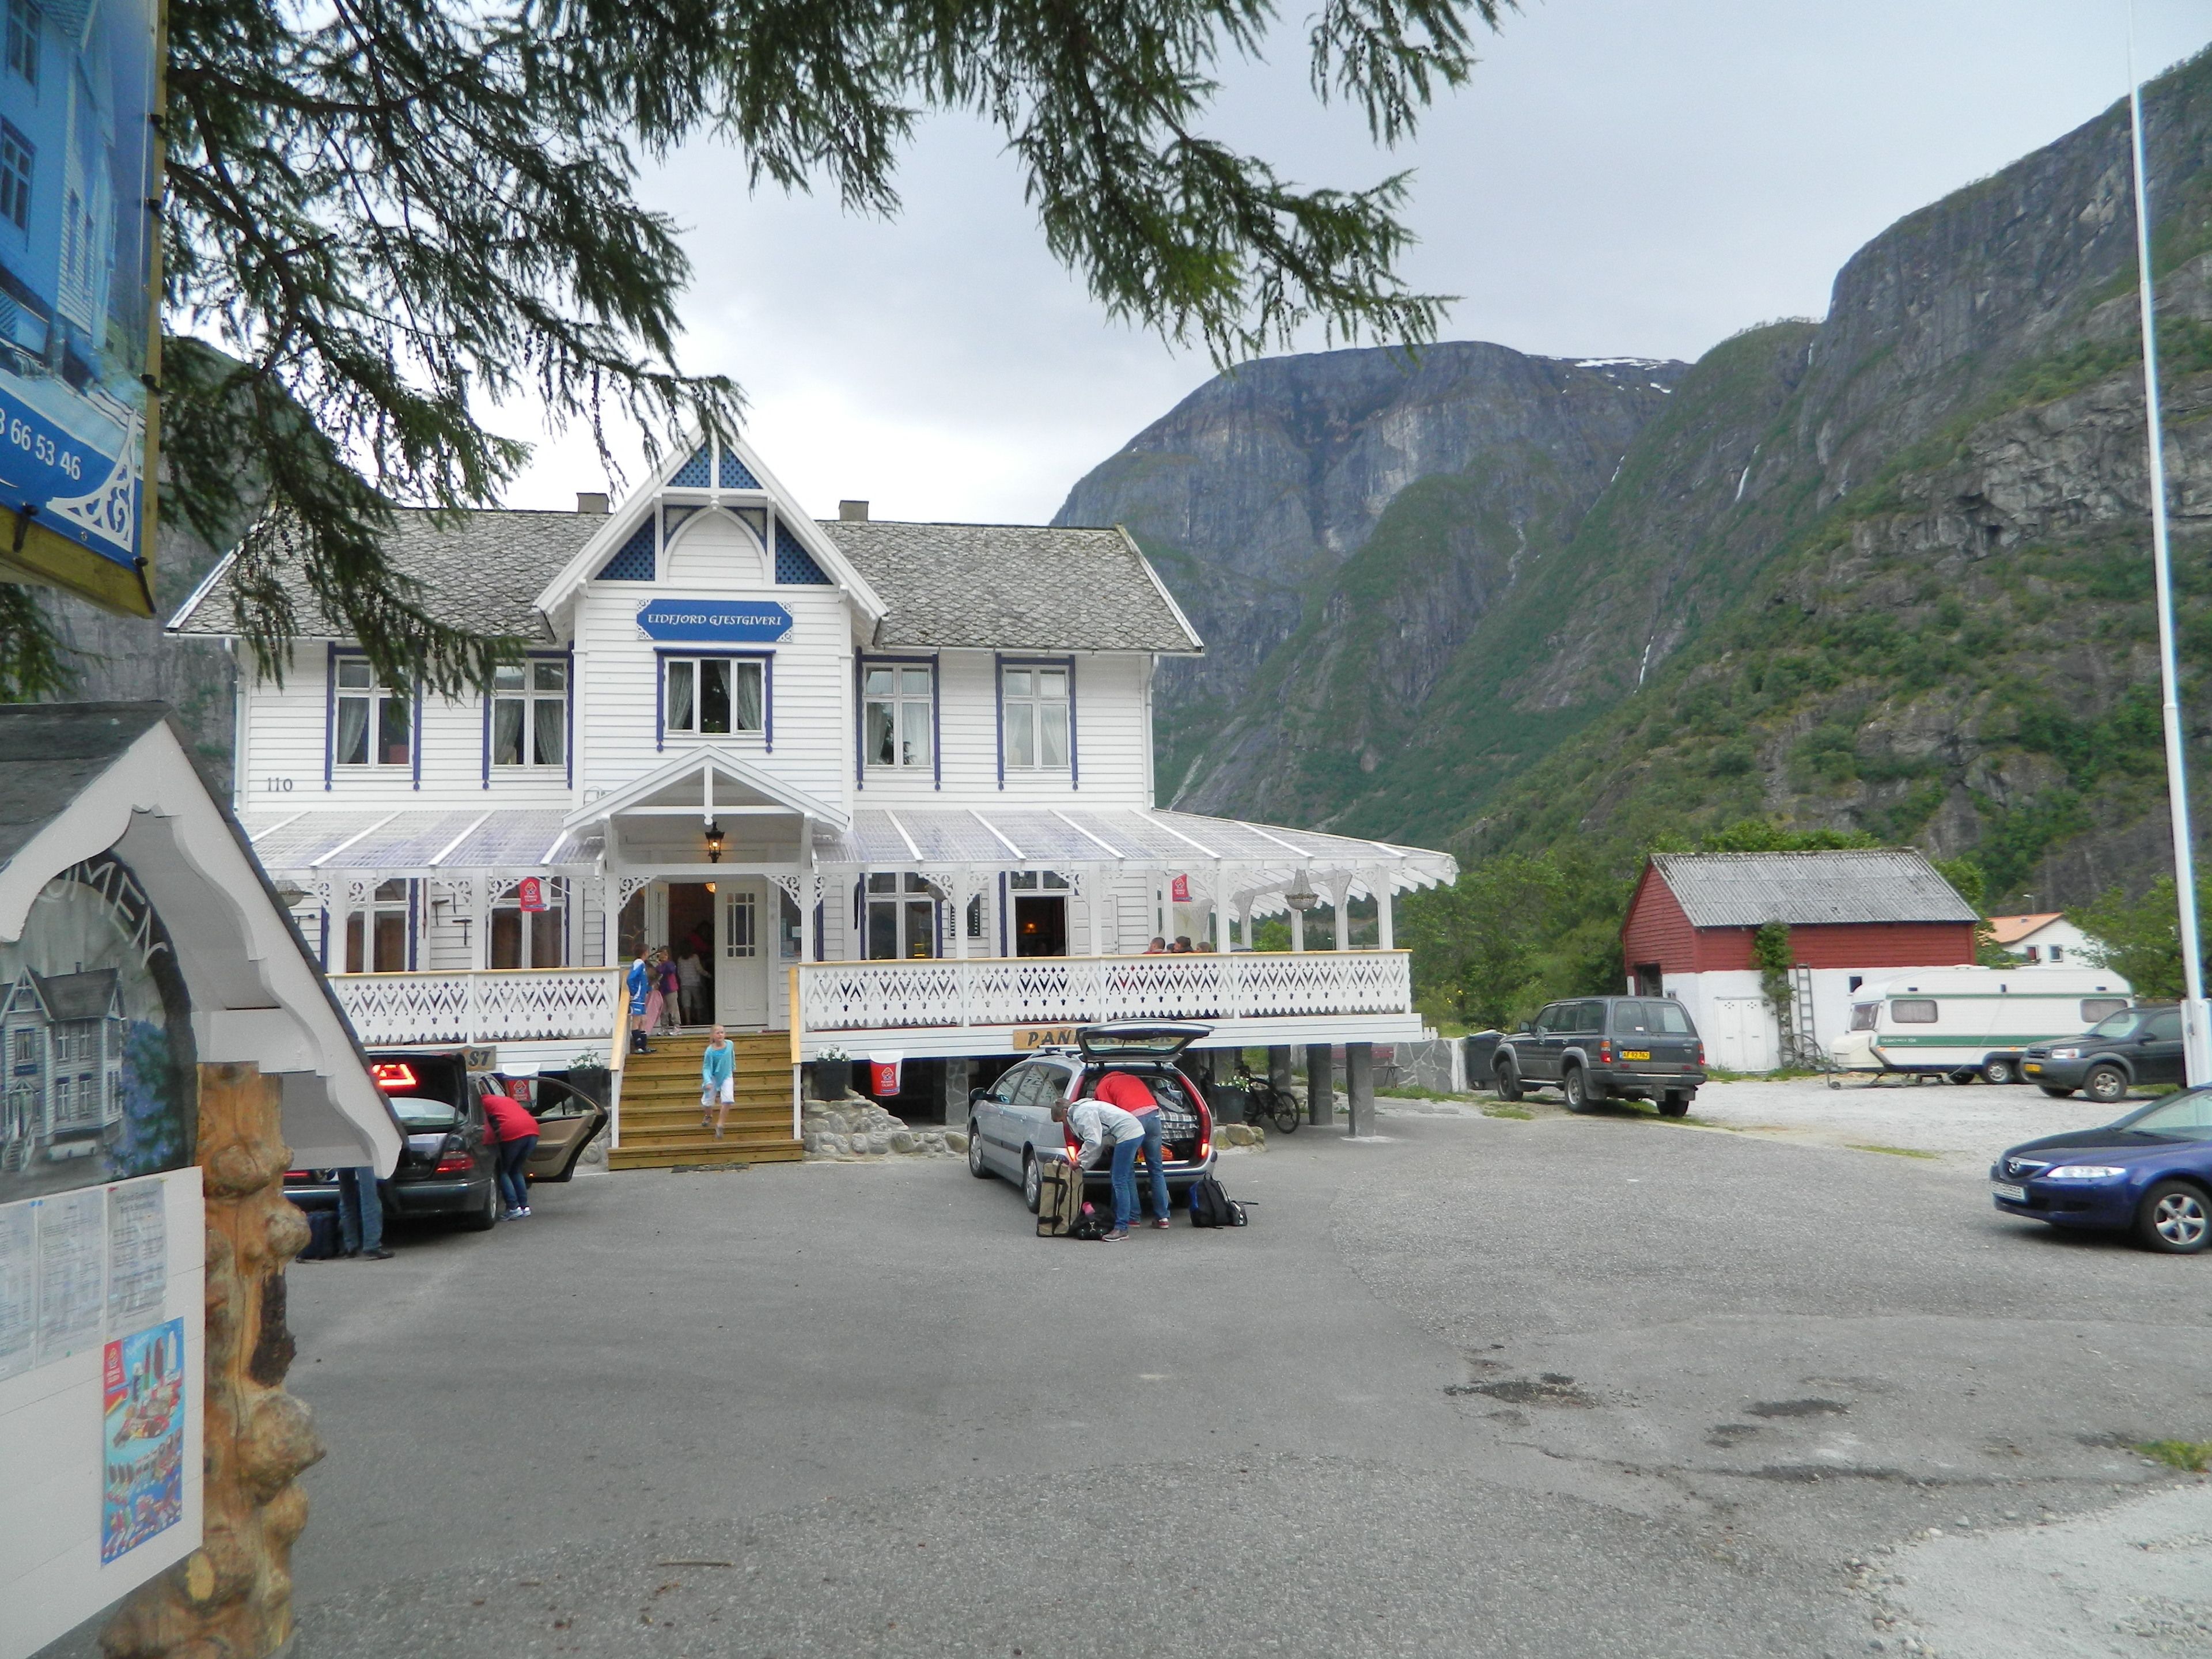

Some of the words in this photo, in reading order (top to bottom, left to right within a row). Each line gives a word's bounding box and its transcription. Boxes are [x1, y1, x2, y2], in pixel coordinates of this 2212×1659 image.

[10, 418, 32, 451] 66
[35, 434, 55, 467] 53
[60, 451, 82, 480] 46
[647, 614, 707, 626] EIDFJORD
[709, 615, 782, 626] GJESTGIVERI
[268, 777, 293, 792] 110
[46, 861, 169, 969] OMEN
